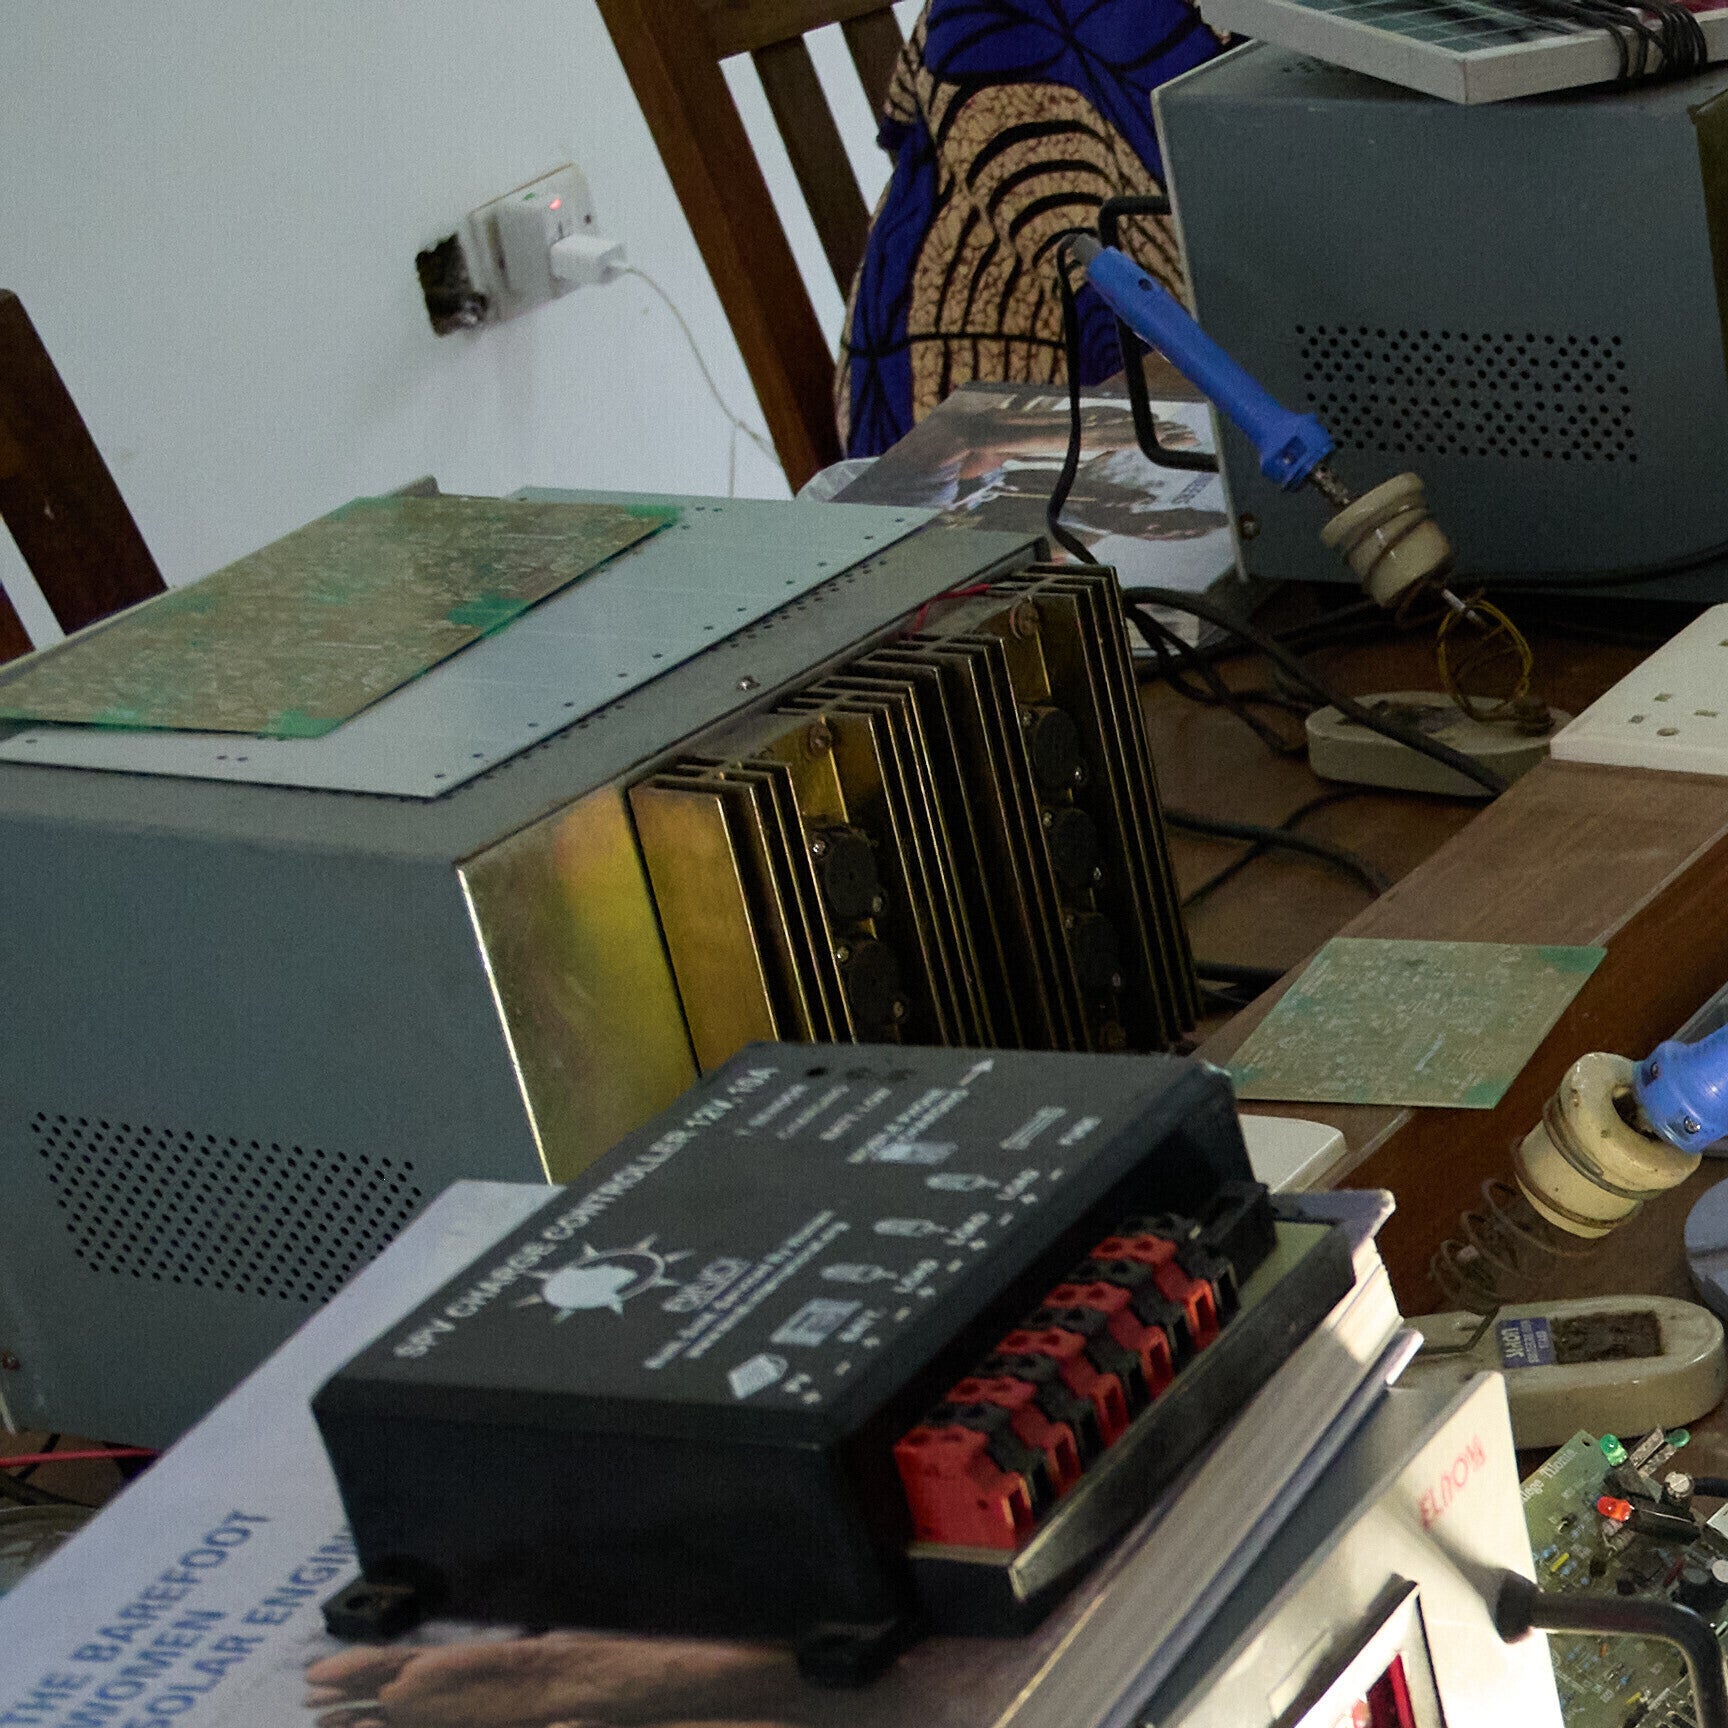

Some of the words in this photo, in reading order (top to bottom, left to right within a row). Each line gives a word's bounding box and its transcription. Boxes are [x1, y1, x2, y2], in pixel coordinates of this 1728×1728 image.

[445, 1240, 558, 1318] CHARGE
[541, 1128, 690, 1242] CONTROLLER
[0, 1672, 94, 1726] THE
[70, 1508, 272, 1664] BAREFOOT
[242, 1531, 357, 1627] ENGIN
